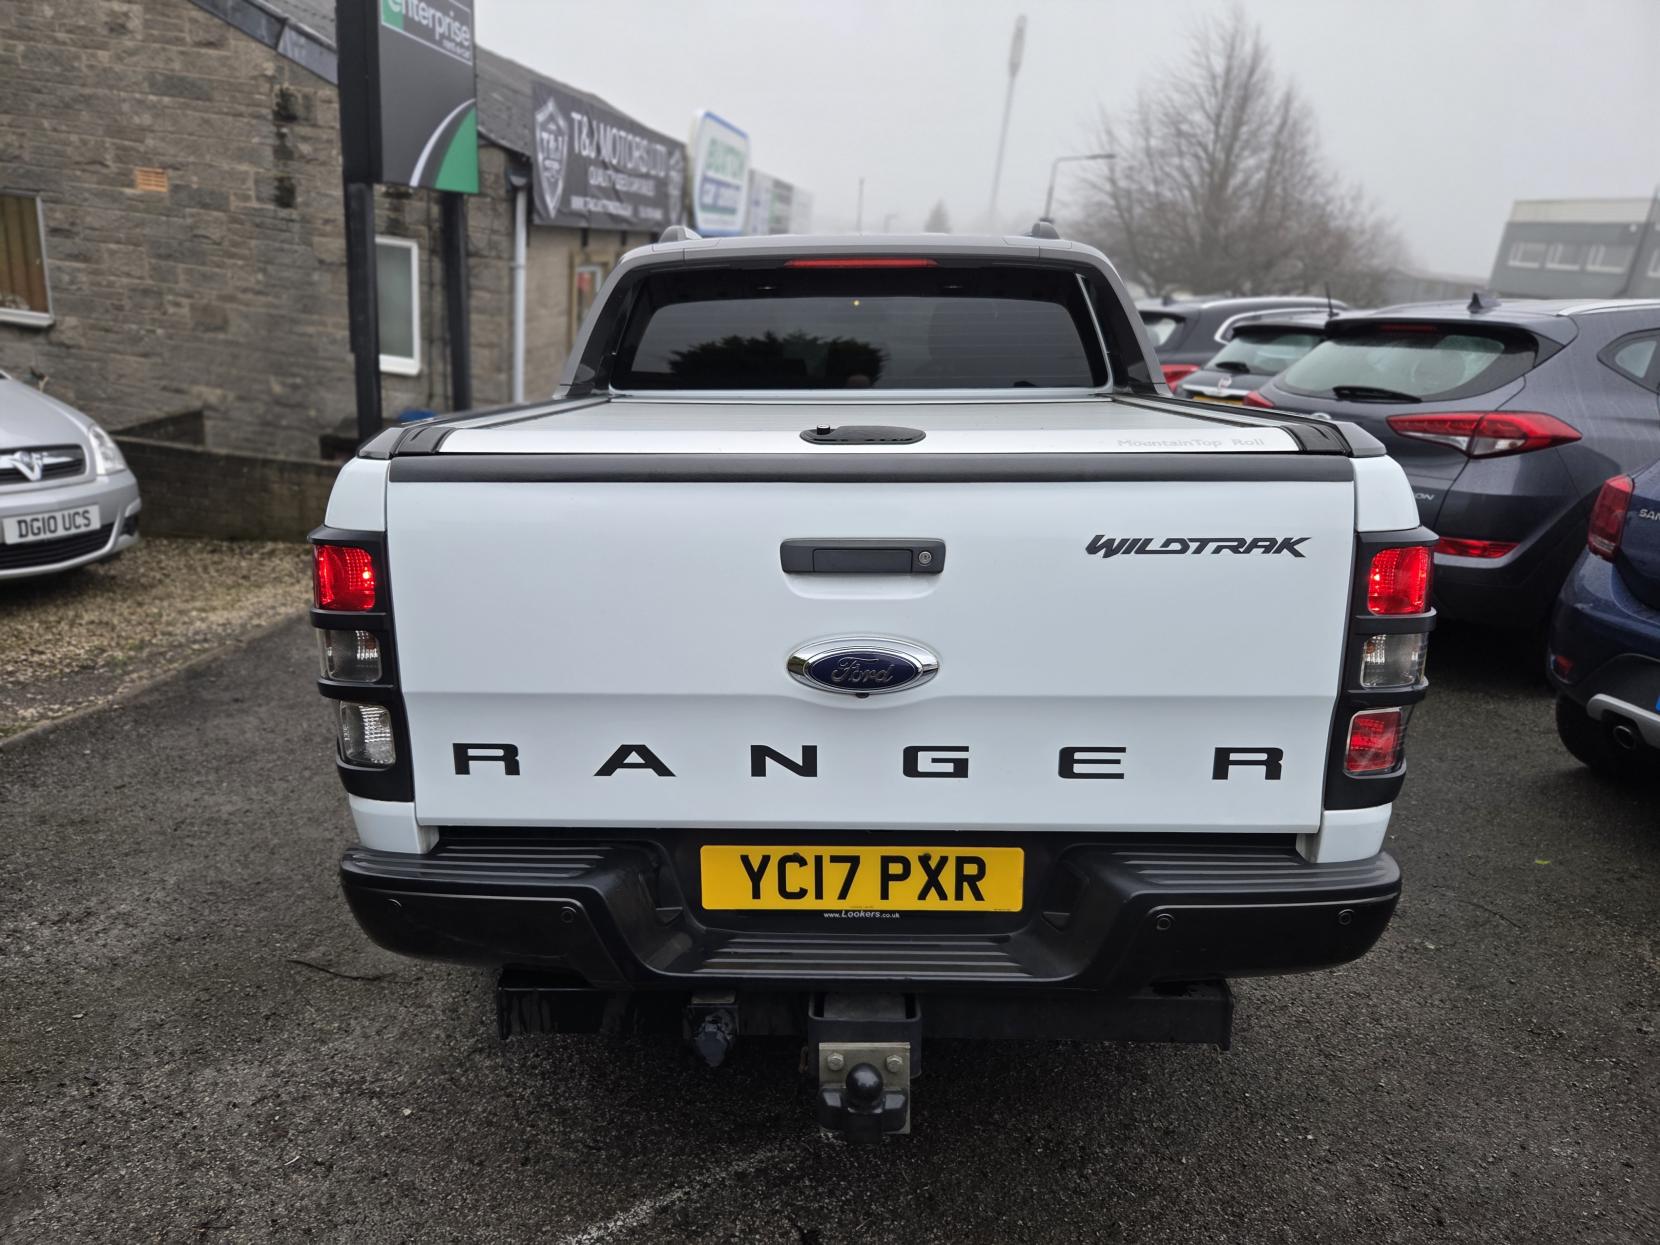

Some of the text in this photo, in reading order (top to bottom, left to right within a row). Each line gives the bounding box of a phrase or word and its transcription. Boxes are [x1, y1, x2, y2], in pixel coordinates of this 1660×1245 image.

[387, 0, 470, 46] enterprise
[571, 111, 598, 158] T&J
[600, 122, 648, 173] MOTORS
[1117, 438, 1264, 448] MountainTop Roll
[17, 509, 91, 539] DG10 UCS
[1085, 534, 1312, 558] WILDTRAK
[831, 656, 895, 682] Ford
[452, 742, 1284, 781] RANGER
[740, 854, 986, 902] YC17 PXR
[823, 909, 900, 919] www.Lookers.co.uk
